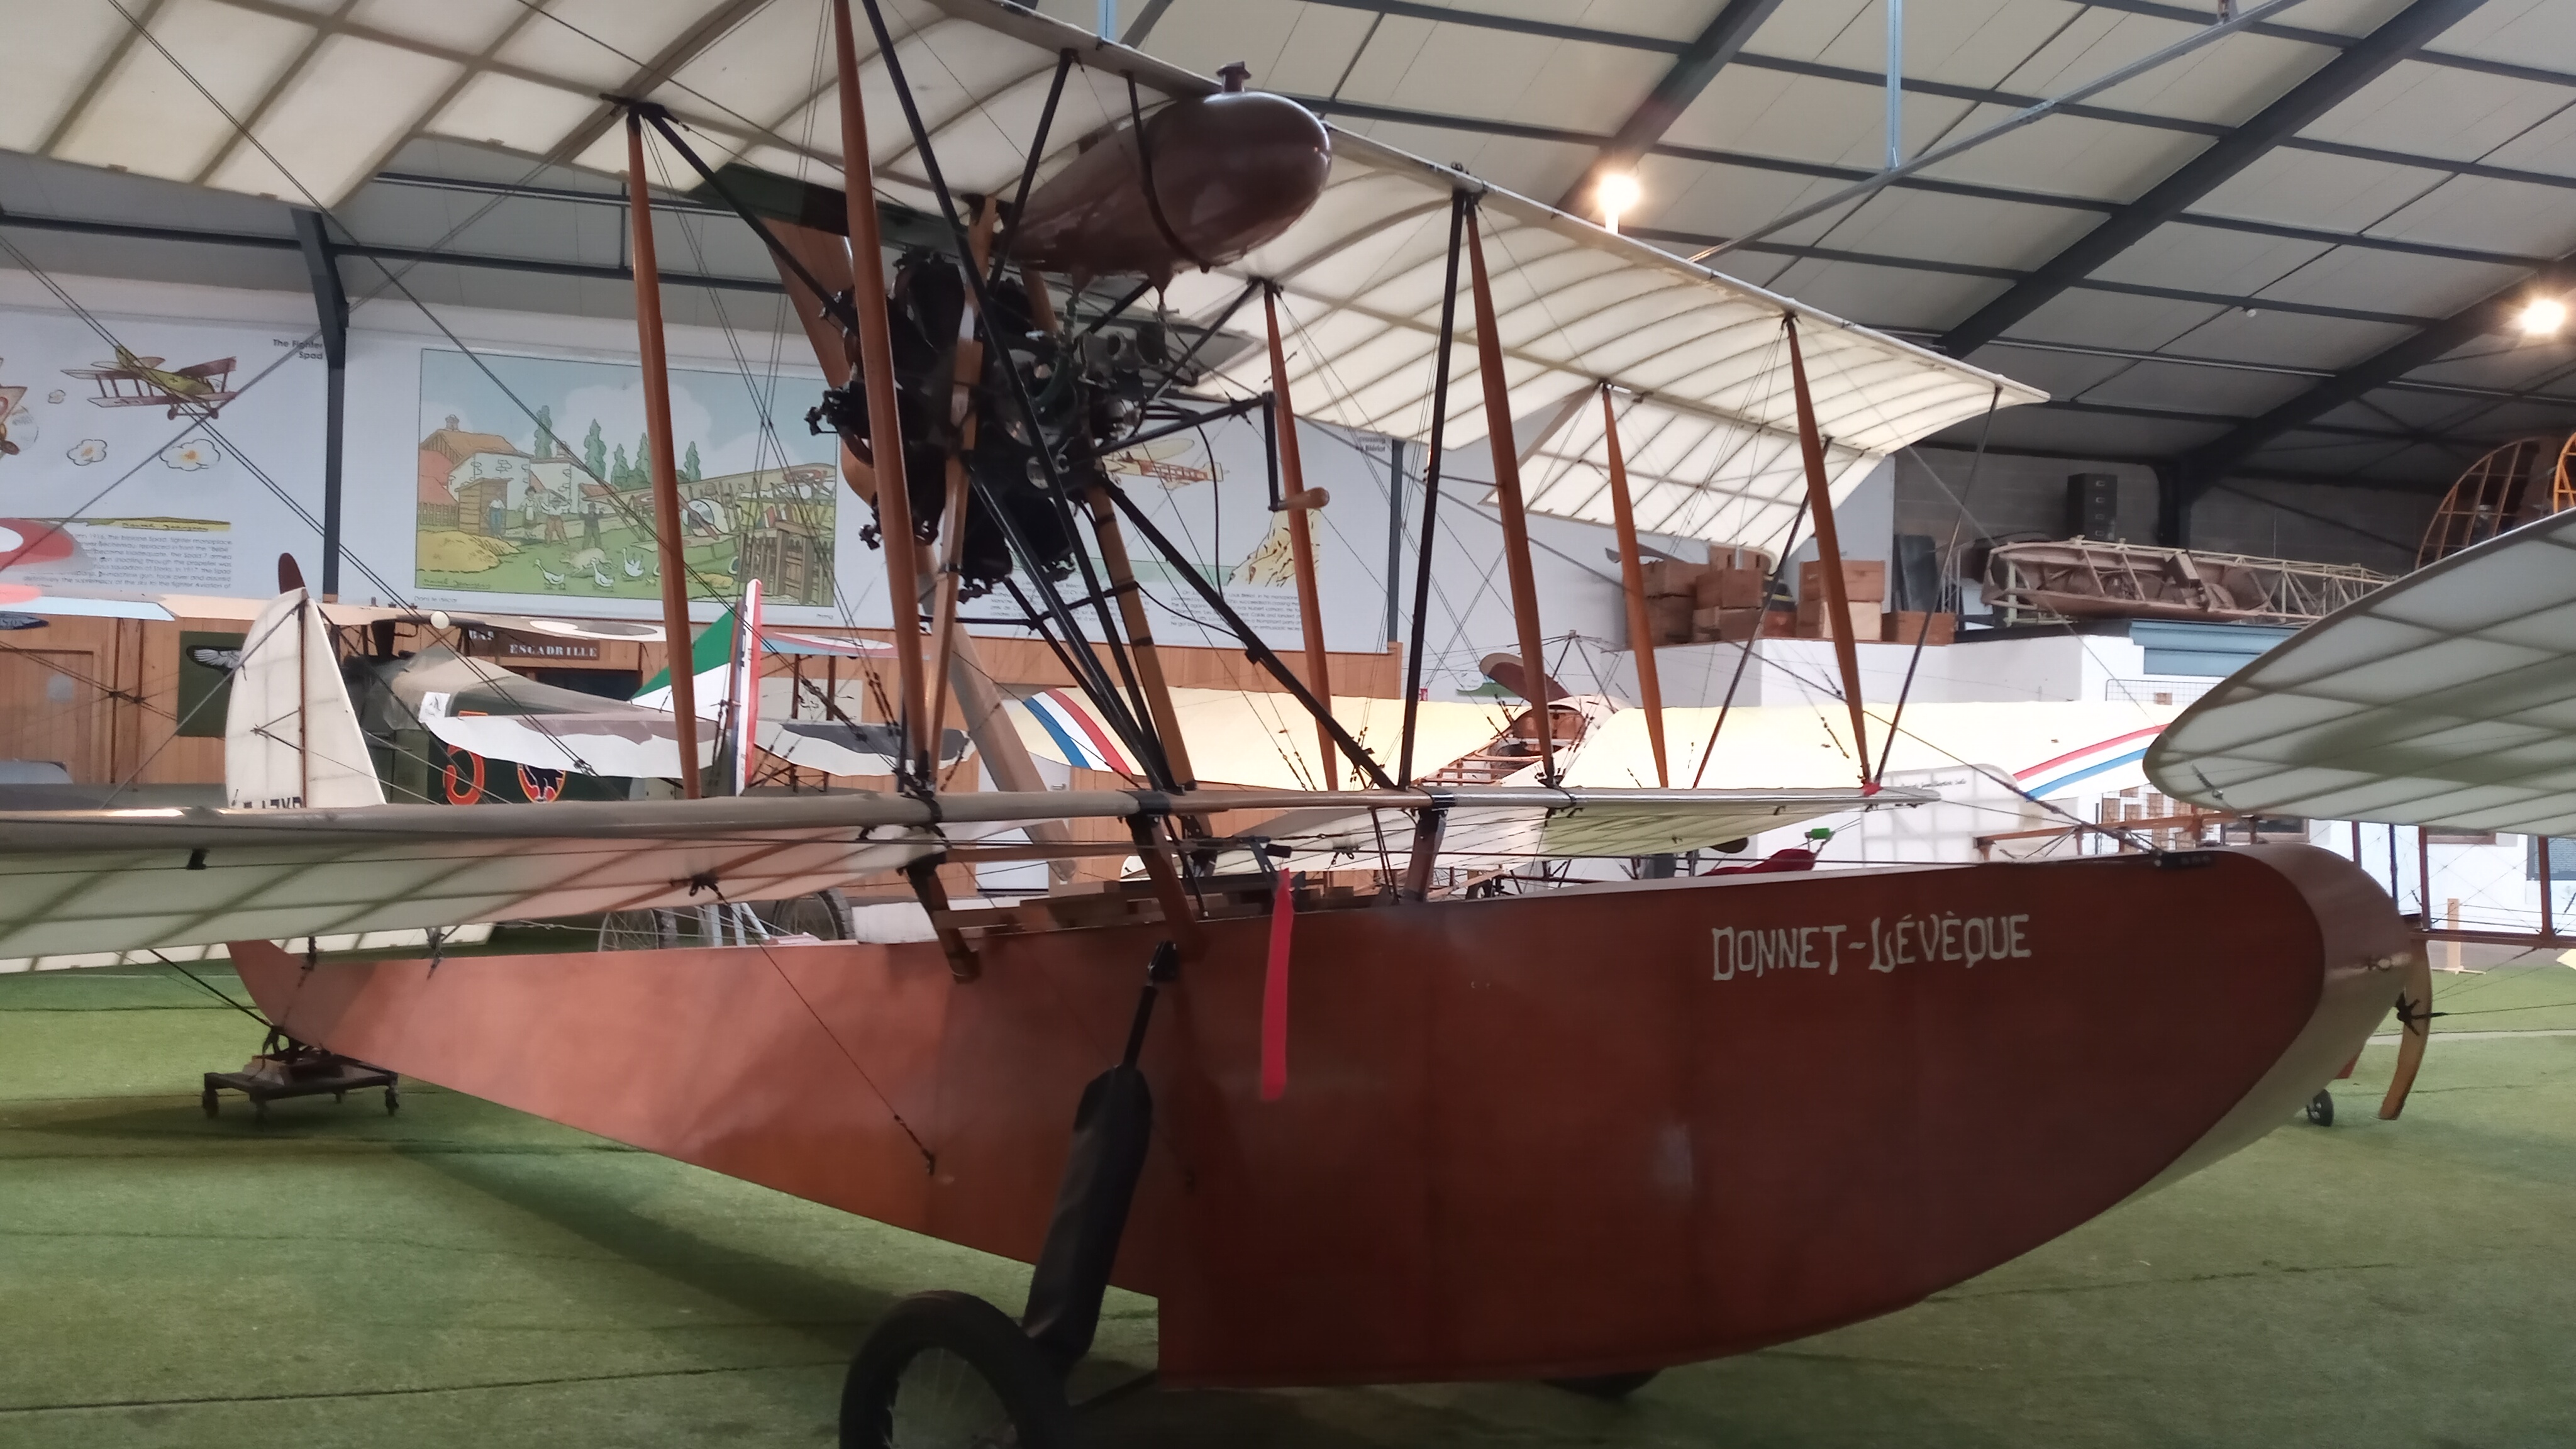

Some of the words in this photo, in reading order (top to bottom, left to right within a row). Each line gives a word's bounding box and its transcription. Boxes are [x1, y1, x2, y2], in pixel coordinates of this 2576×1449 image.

[273, 339, 289, 347] The
[299, 351, 323, 360] Spad
[509, 644, 597, 657] ESCADRILLE
